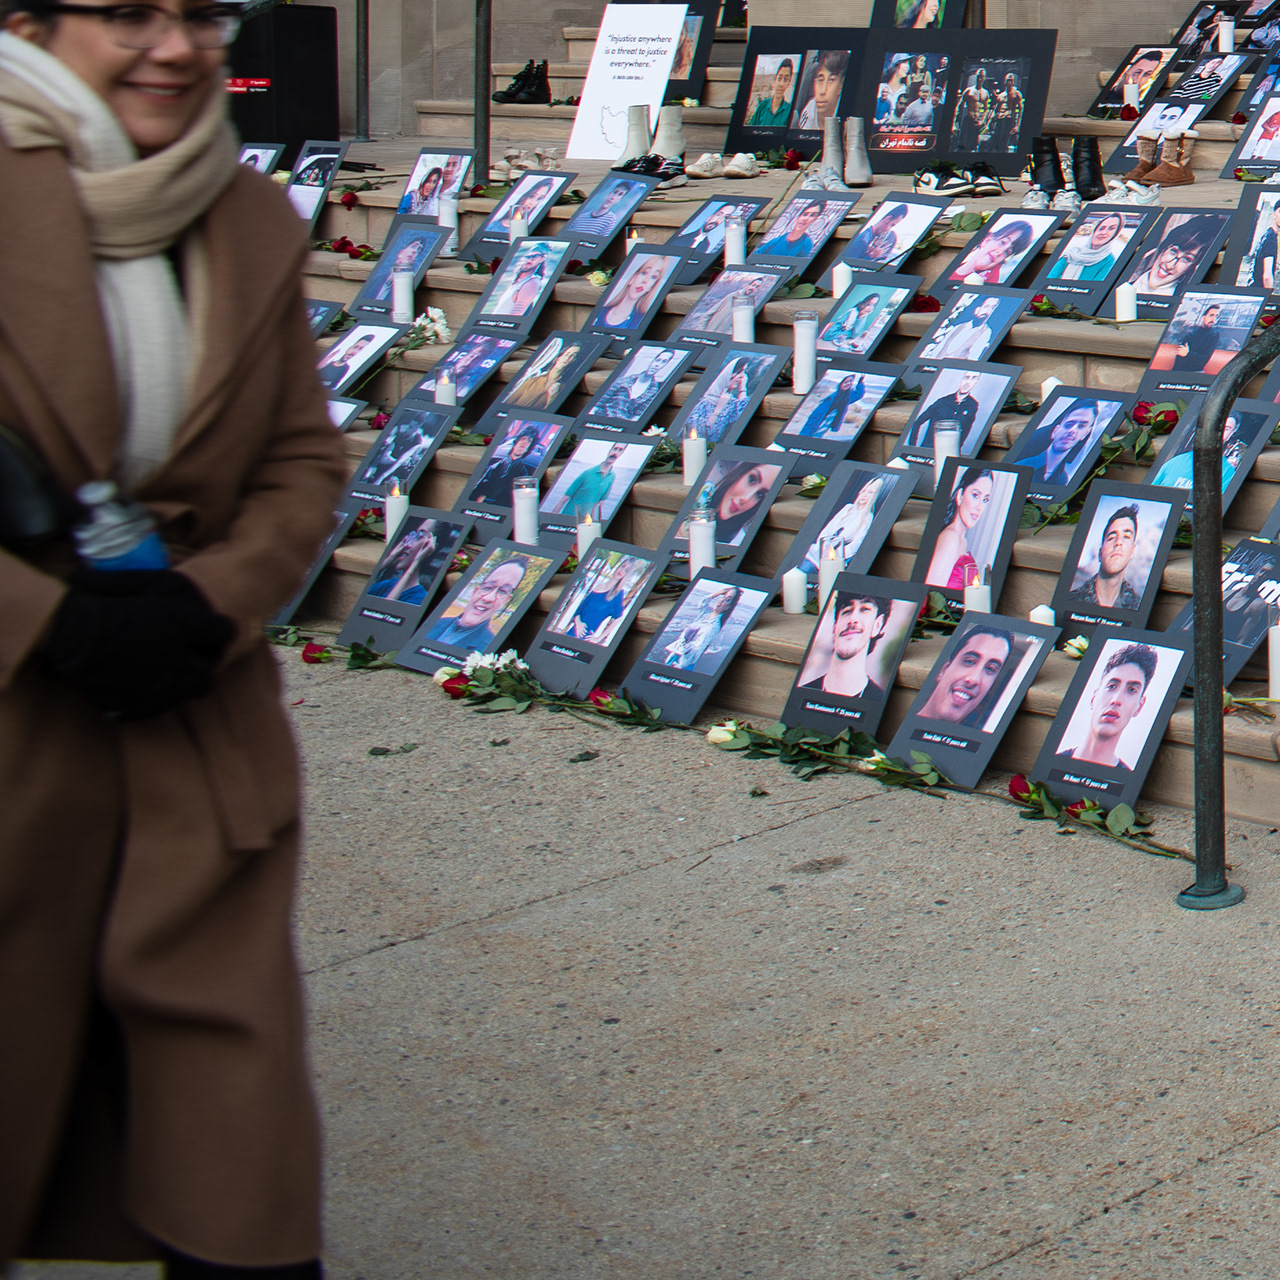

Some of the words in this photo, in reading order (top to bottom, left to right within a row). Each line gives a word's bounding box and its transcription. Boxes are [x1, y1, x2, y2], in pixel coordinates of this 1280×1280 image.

[638, 34, 672, 45] anywhere
[604, 46, 611, 55] is
[617, 46, 638, 55] threat
[638, 47, 646, 55] to
[645, 46, 668, 58] justice
